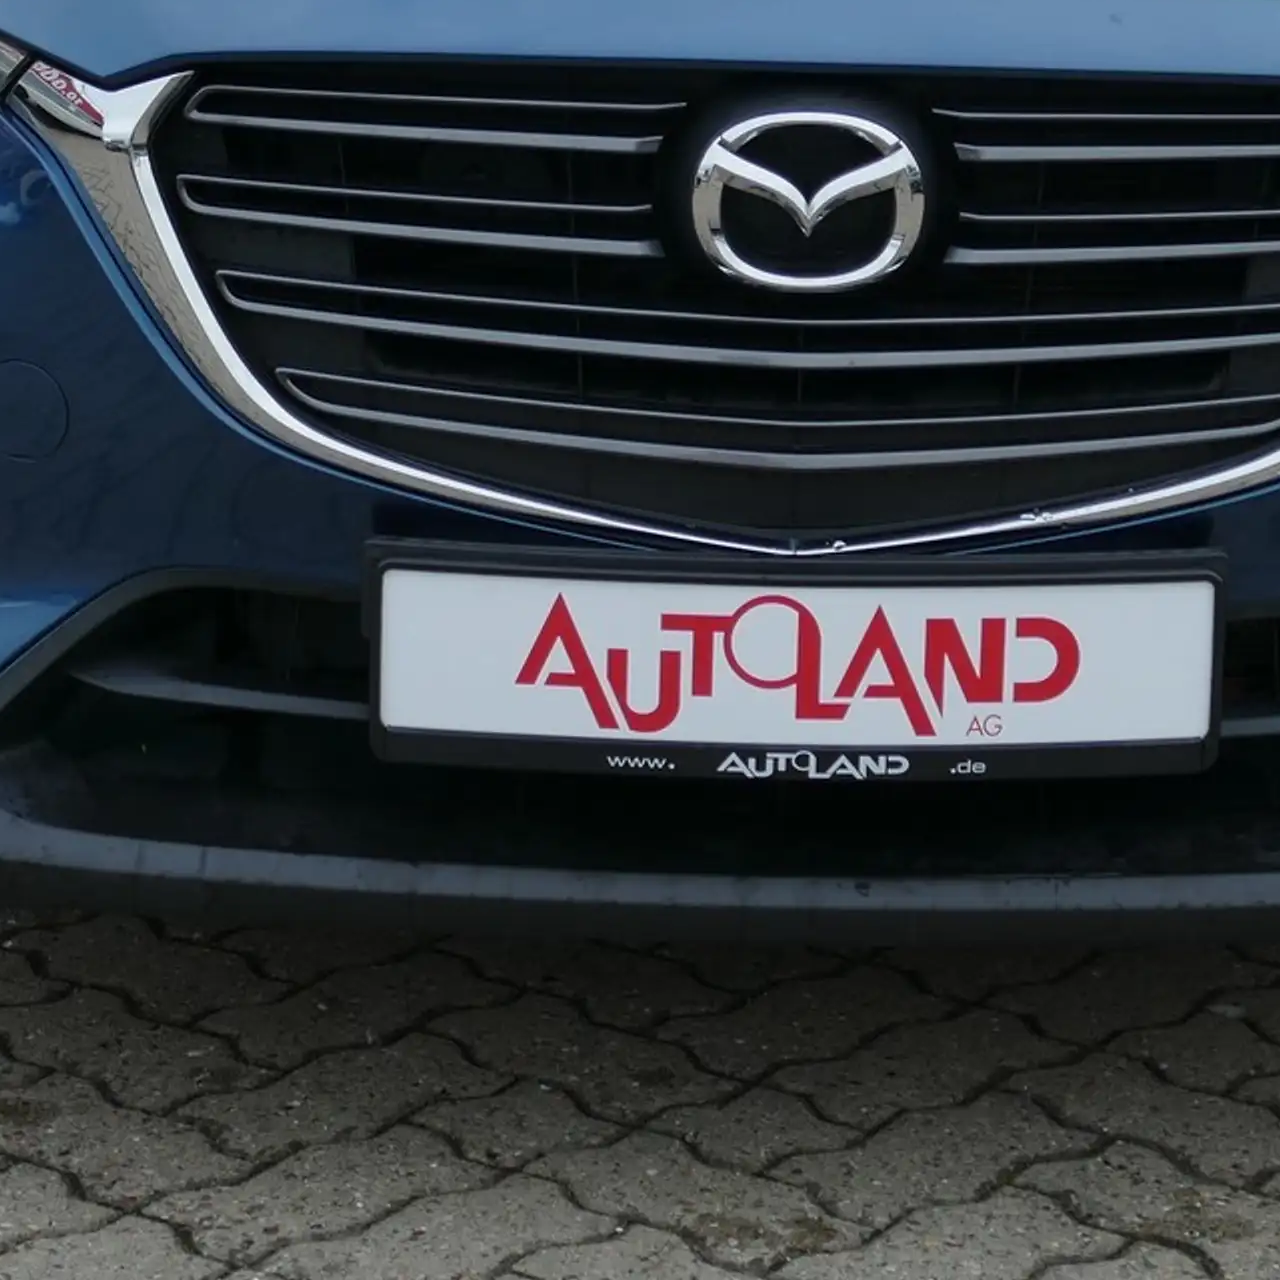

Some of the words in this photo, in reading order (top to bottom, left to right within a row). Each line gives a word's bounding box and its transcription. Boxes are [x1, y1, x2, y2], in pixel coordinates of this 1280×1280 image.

[515, 592, 1080, 737] AUTOLAND
[965, 714, 1004, 737] AG
[606, 754, 676, 770] www.
[716, 750, 910, 780] AUTOLAND
[949, 759, 987, 775] .de
